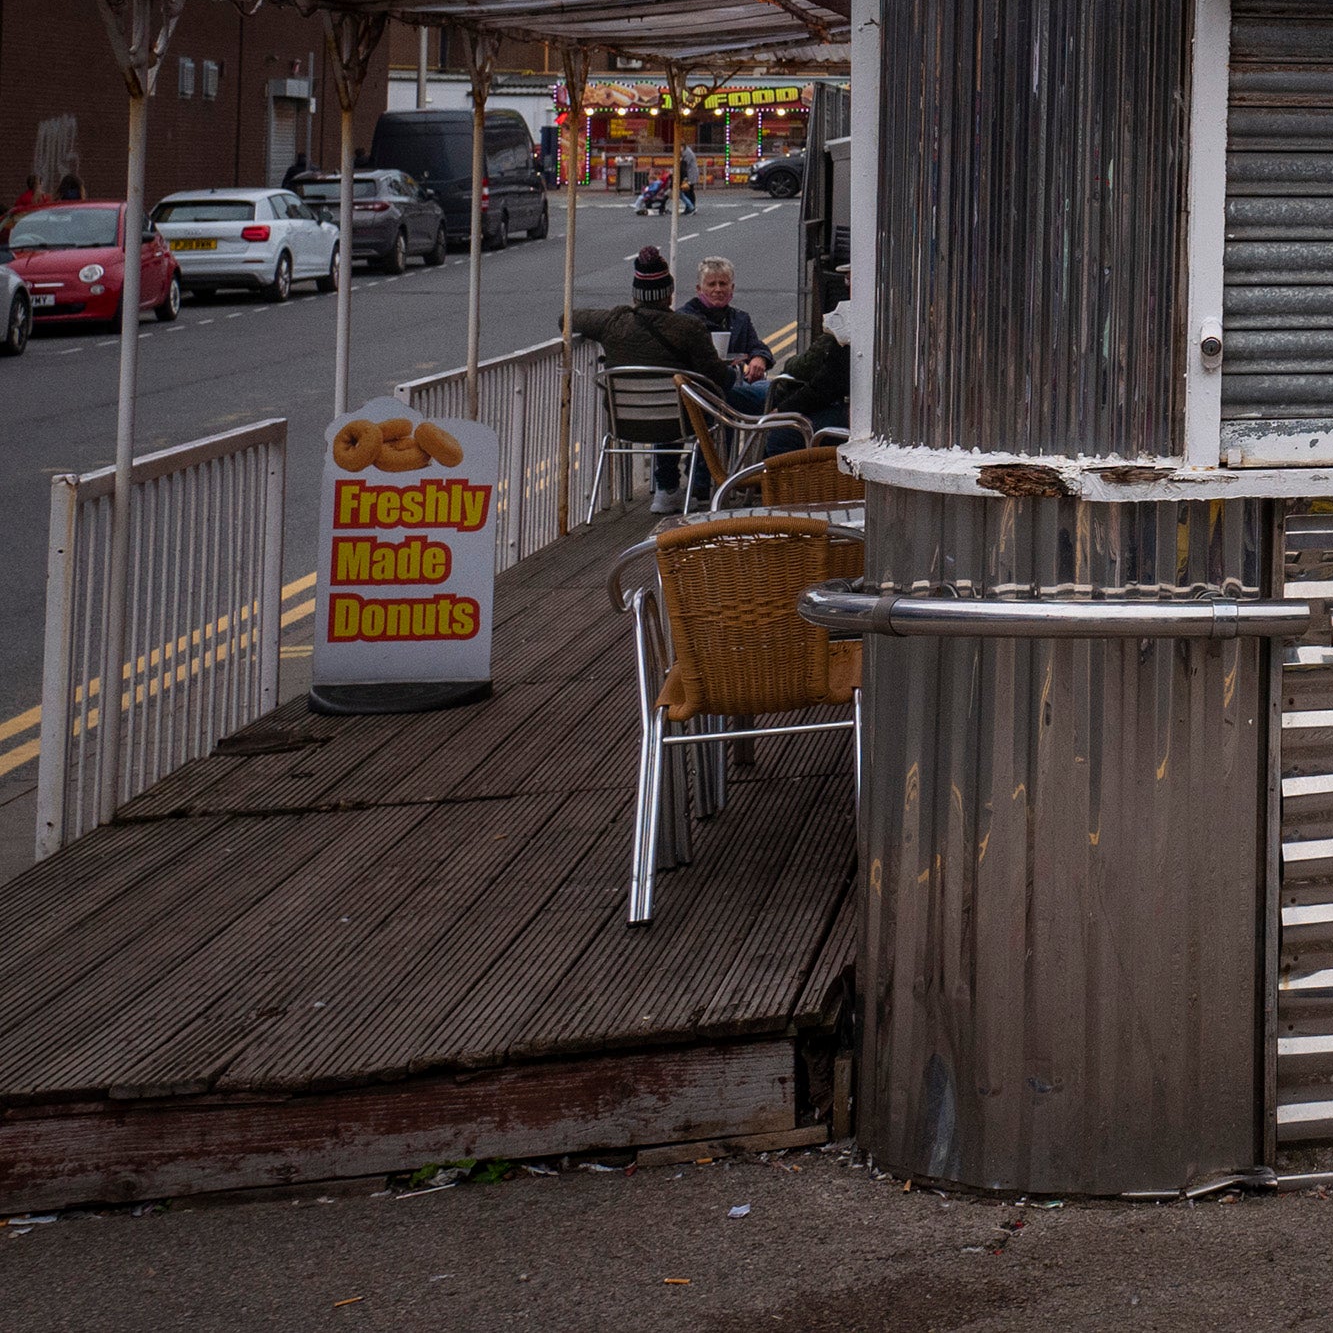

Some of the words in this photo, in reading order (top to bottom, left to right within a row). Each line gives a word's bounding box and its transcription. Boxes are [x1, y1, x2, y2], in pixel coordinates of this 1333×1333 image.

[704, 87, 799, 109] FOOD
[340, 485, 485, 527] Freshly
[337, 541, 446, 580] Made
[334, 599, 474, 637] Donuts
